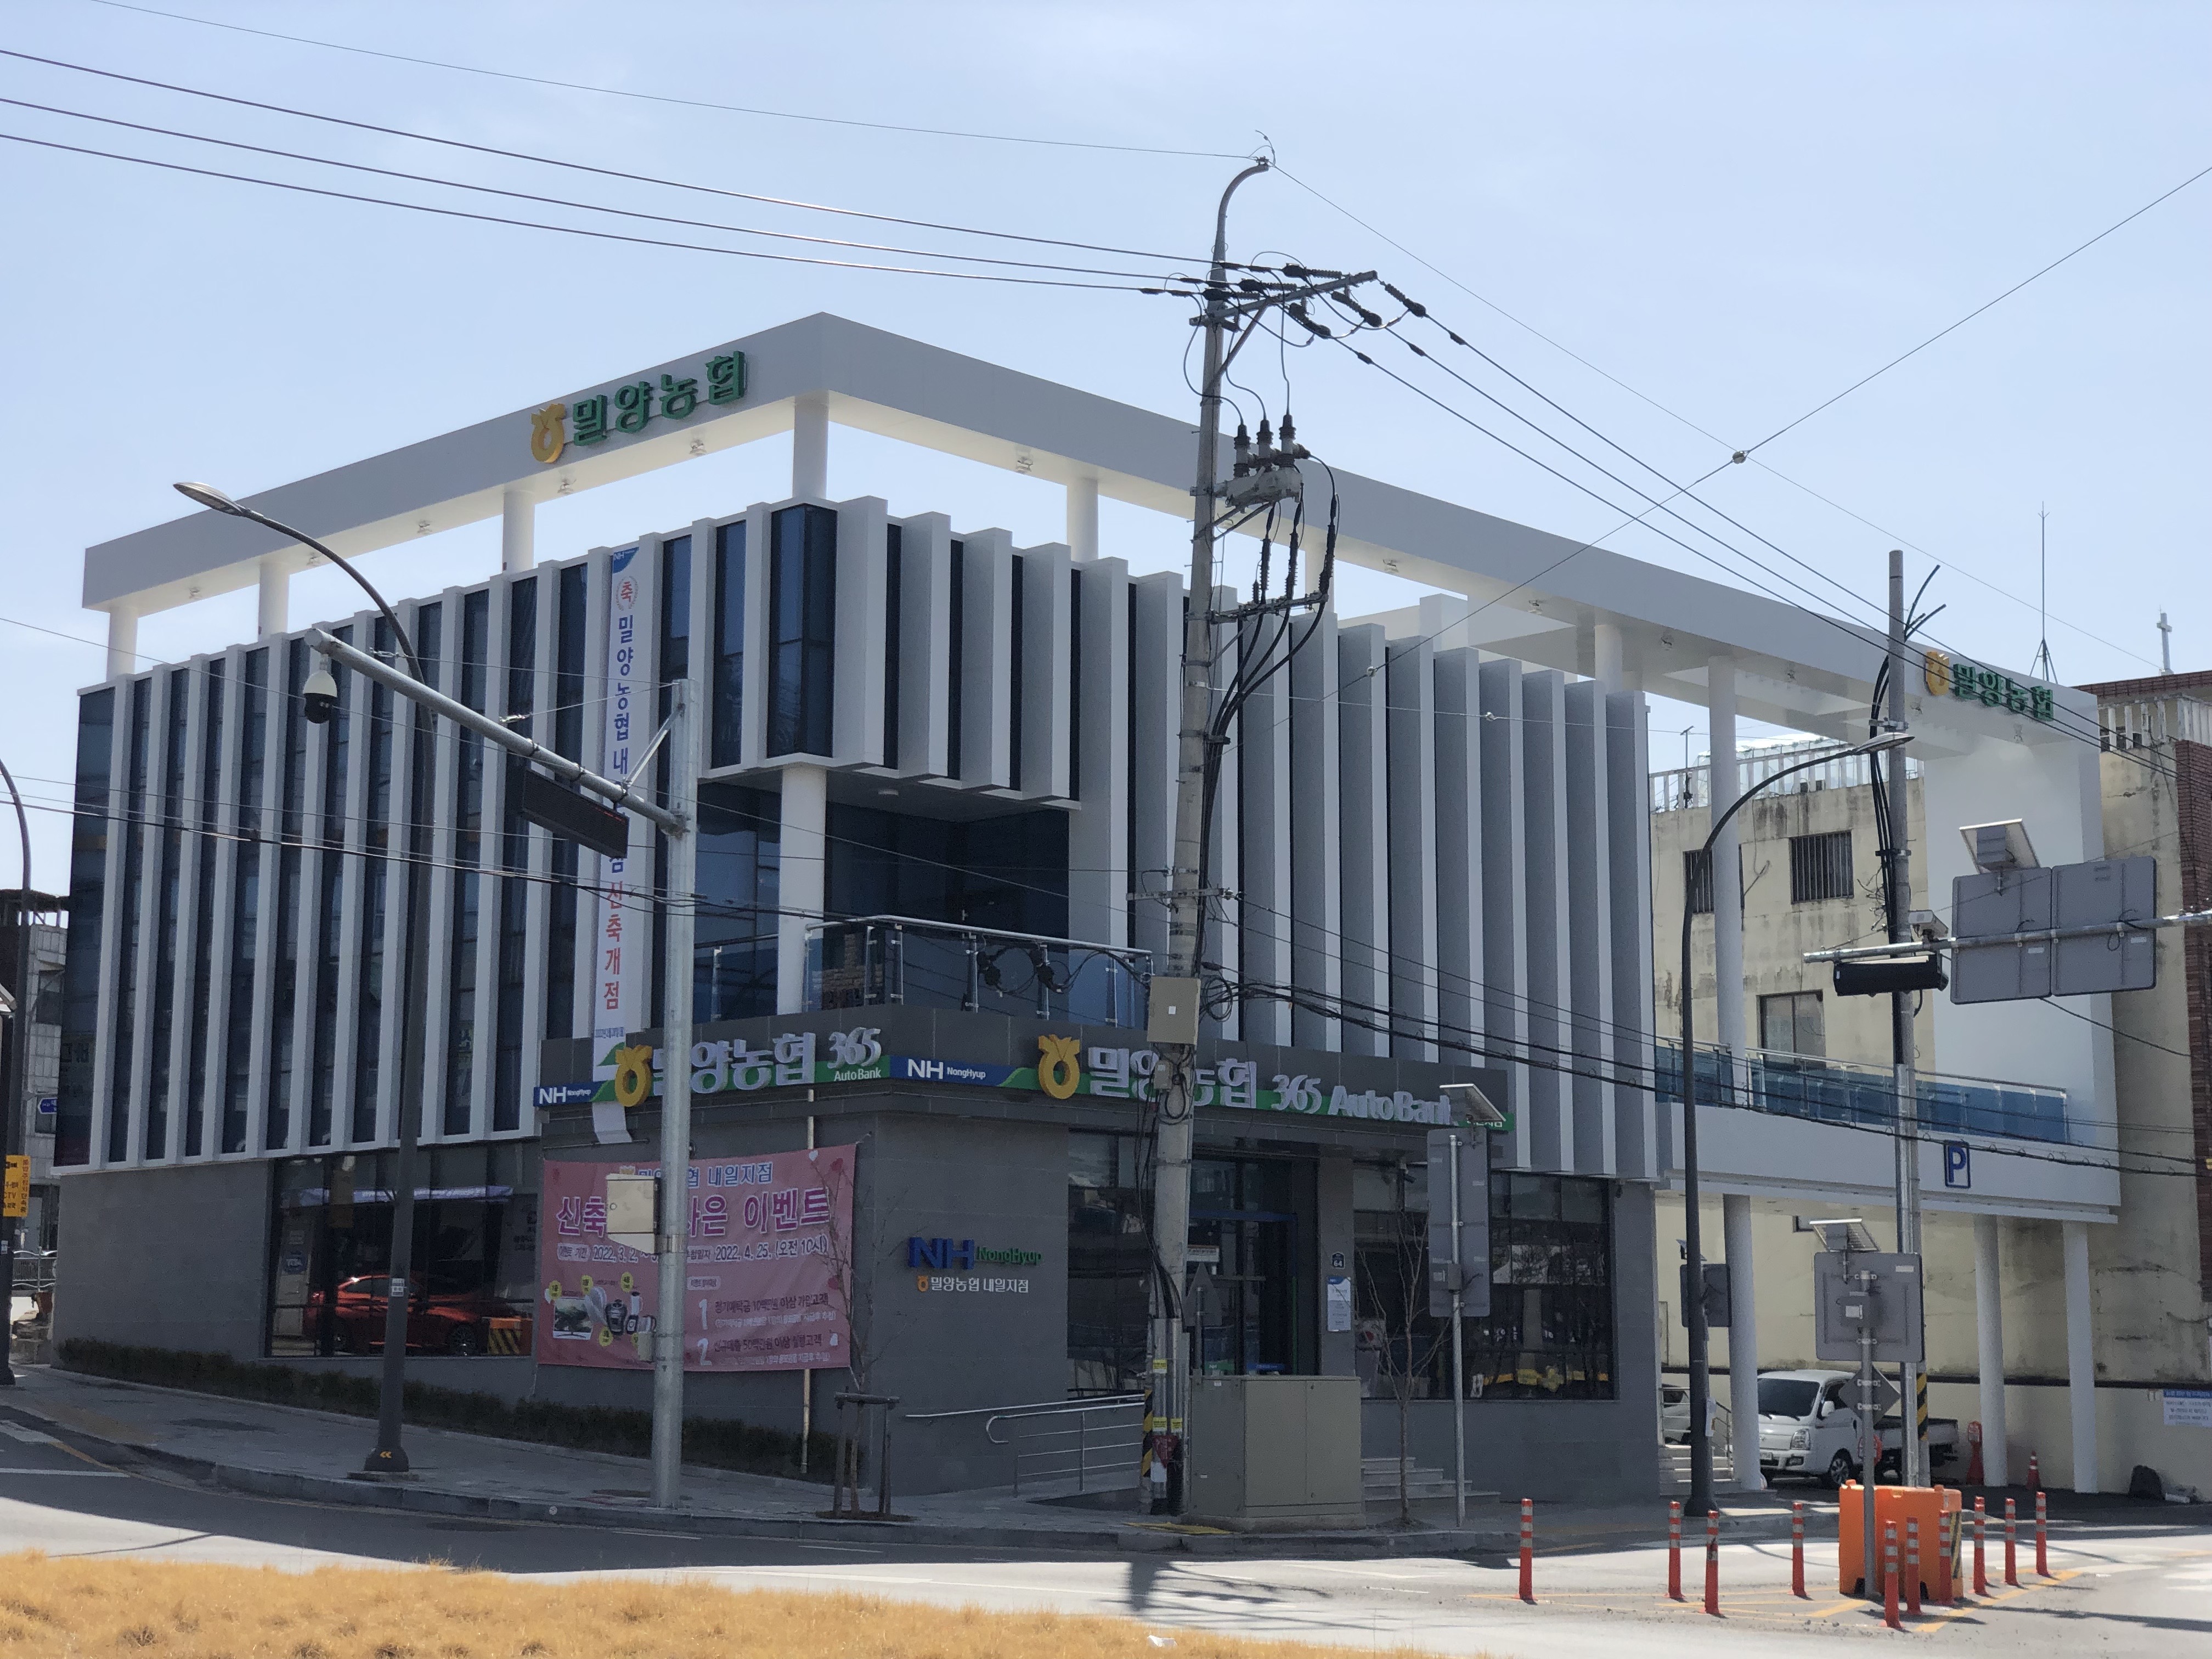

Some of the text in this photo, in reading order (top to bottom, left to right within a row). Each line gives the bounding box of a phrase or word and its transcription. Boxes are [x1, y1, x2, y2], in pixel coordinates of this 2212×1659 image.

[572, 350, 746, 447] 밀양농협
[620, 581, 633, 602] 축
[614, 614, 634, 742] 밀양농협
[1953, 663, 2054, 721] 밀양농협
[603, 881, 623, 1010] 신축개점
[652, 1026, 882, 1096] 양농협 365
[907, 1059, 986, 1079] NH NongHyup
[539, 1087, 566, 1104] NH
[1088, 1047, 1257, 1109] 밀협
[1271, 1074, 1321, 1114] 365
[708, 1162, 773, 1187] 내일지점
[1949, 1146, 1966, 1183] P
[743, 1186, 830, 1235] 이벤트
[715, 1245, 741, 1261] 2022.
[756, 1242, 772, 1259] 25.
[907, 1237, 1043, 1270] NH NongHyup
[930, 1277, 1029, 1294] 밀양농협 내일지점
[698, 1298, 708, 1330] 1
[780, 1295, 796, 1310] 이상
[697, 1337, 712, 1366] 2
[774, 1336, 791, 1349] 이상
